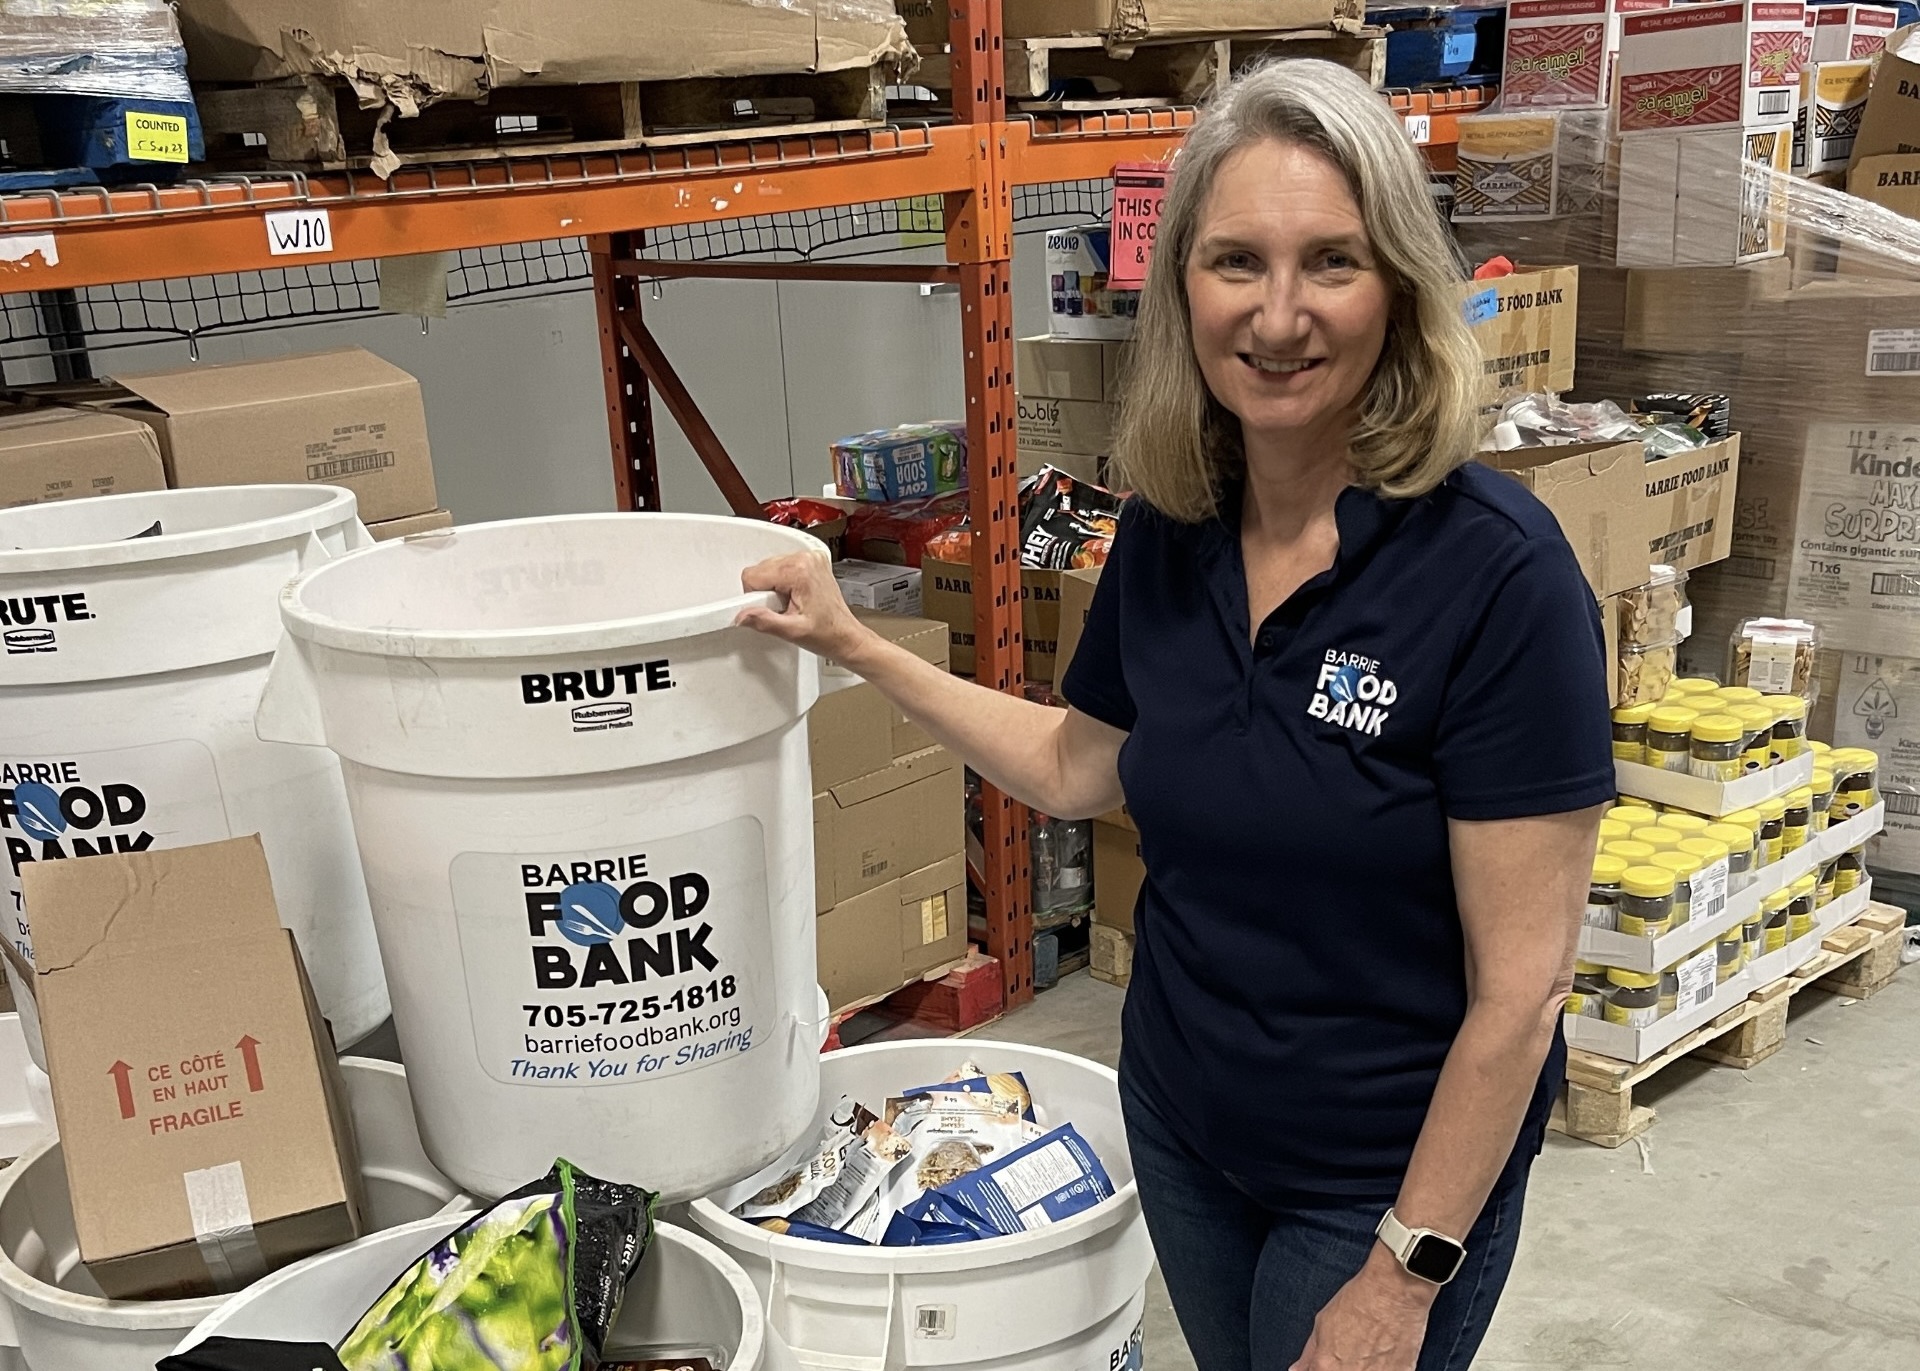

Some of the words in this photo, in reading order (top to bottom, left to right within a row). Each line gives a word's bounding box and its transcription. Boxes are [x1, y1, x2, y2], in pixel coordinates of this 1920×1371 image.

[1511, 46, 1584, 74] caramel
[1636, 84, 1708, 112] caramel
[136, 119, 179, 132] COUNTED
[1480, 181, 1525, 190] CARAMEL
[1118, 198, 1151, 216] THIS
[271, 218, 325, 249] W10
[1119, 222, 1132, 240] IN
[1136, 246, 1145, 263] &
[1507, 293, 1533, 311] FOOD
[1536, 288, 1563, 306] BANK
[896, 460, 926, 484] SODA
[1681, 465, 1704, 487] FOOD
[1706, 457, 1730, 479] BANK
[899, 481, 928, 497] COVE
[1801, 539, 1848, 553] Contains
[1850, 544, 1897, 559] gigantic
[1810, 560, 1841, 575] T1x6
[1325, 648, 1380, 674] BARRIE
[574, 707, 630, 719] Rubbermaid
[1306, 693, 1389, 737] BANK
[0, 762, 80, 784] ARRIE
[521, 854, 648, 887] BARRIE
[532, 922, 719, 989] BANK
[522, 974, 737, 1027] 705-725-1818
[525, 1007, 741, 1054] barriefoodbank.org
[148, 1064, 172, 1082] CE
[180, 1050, 227, 1076] CÔTÉ
[510, 1059, 580, 1079] Thank
[588, 1059, 627, 1079] You
[636, 1055, 669, 1074] for
[674, 1026, 753, 1066] Sharing
[153, 1085, 176, 1102] EN
[184, 1075, 229, 1097] HAUT
[150, 1101, 244, 1135] FRAGILE
[621, 1234, 637, 1265] avec
